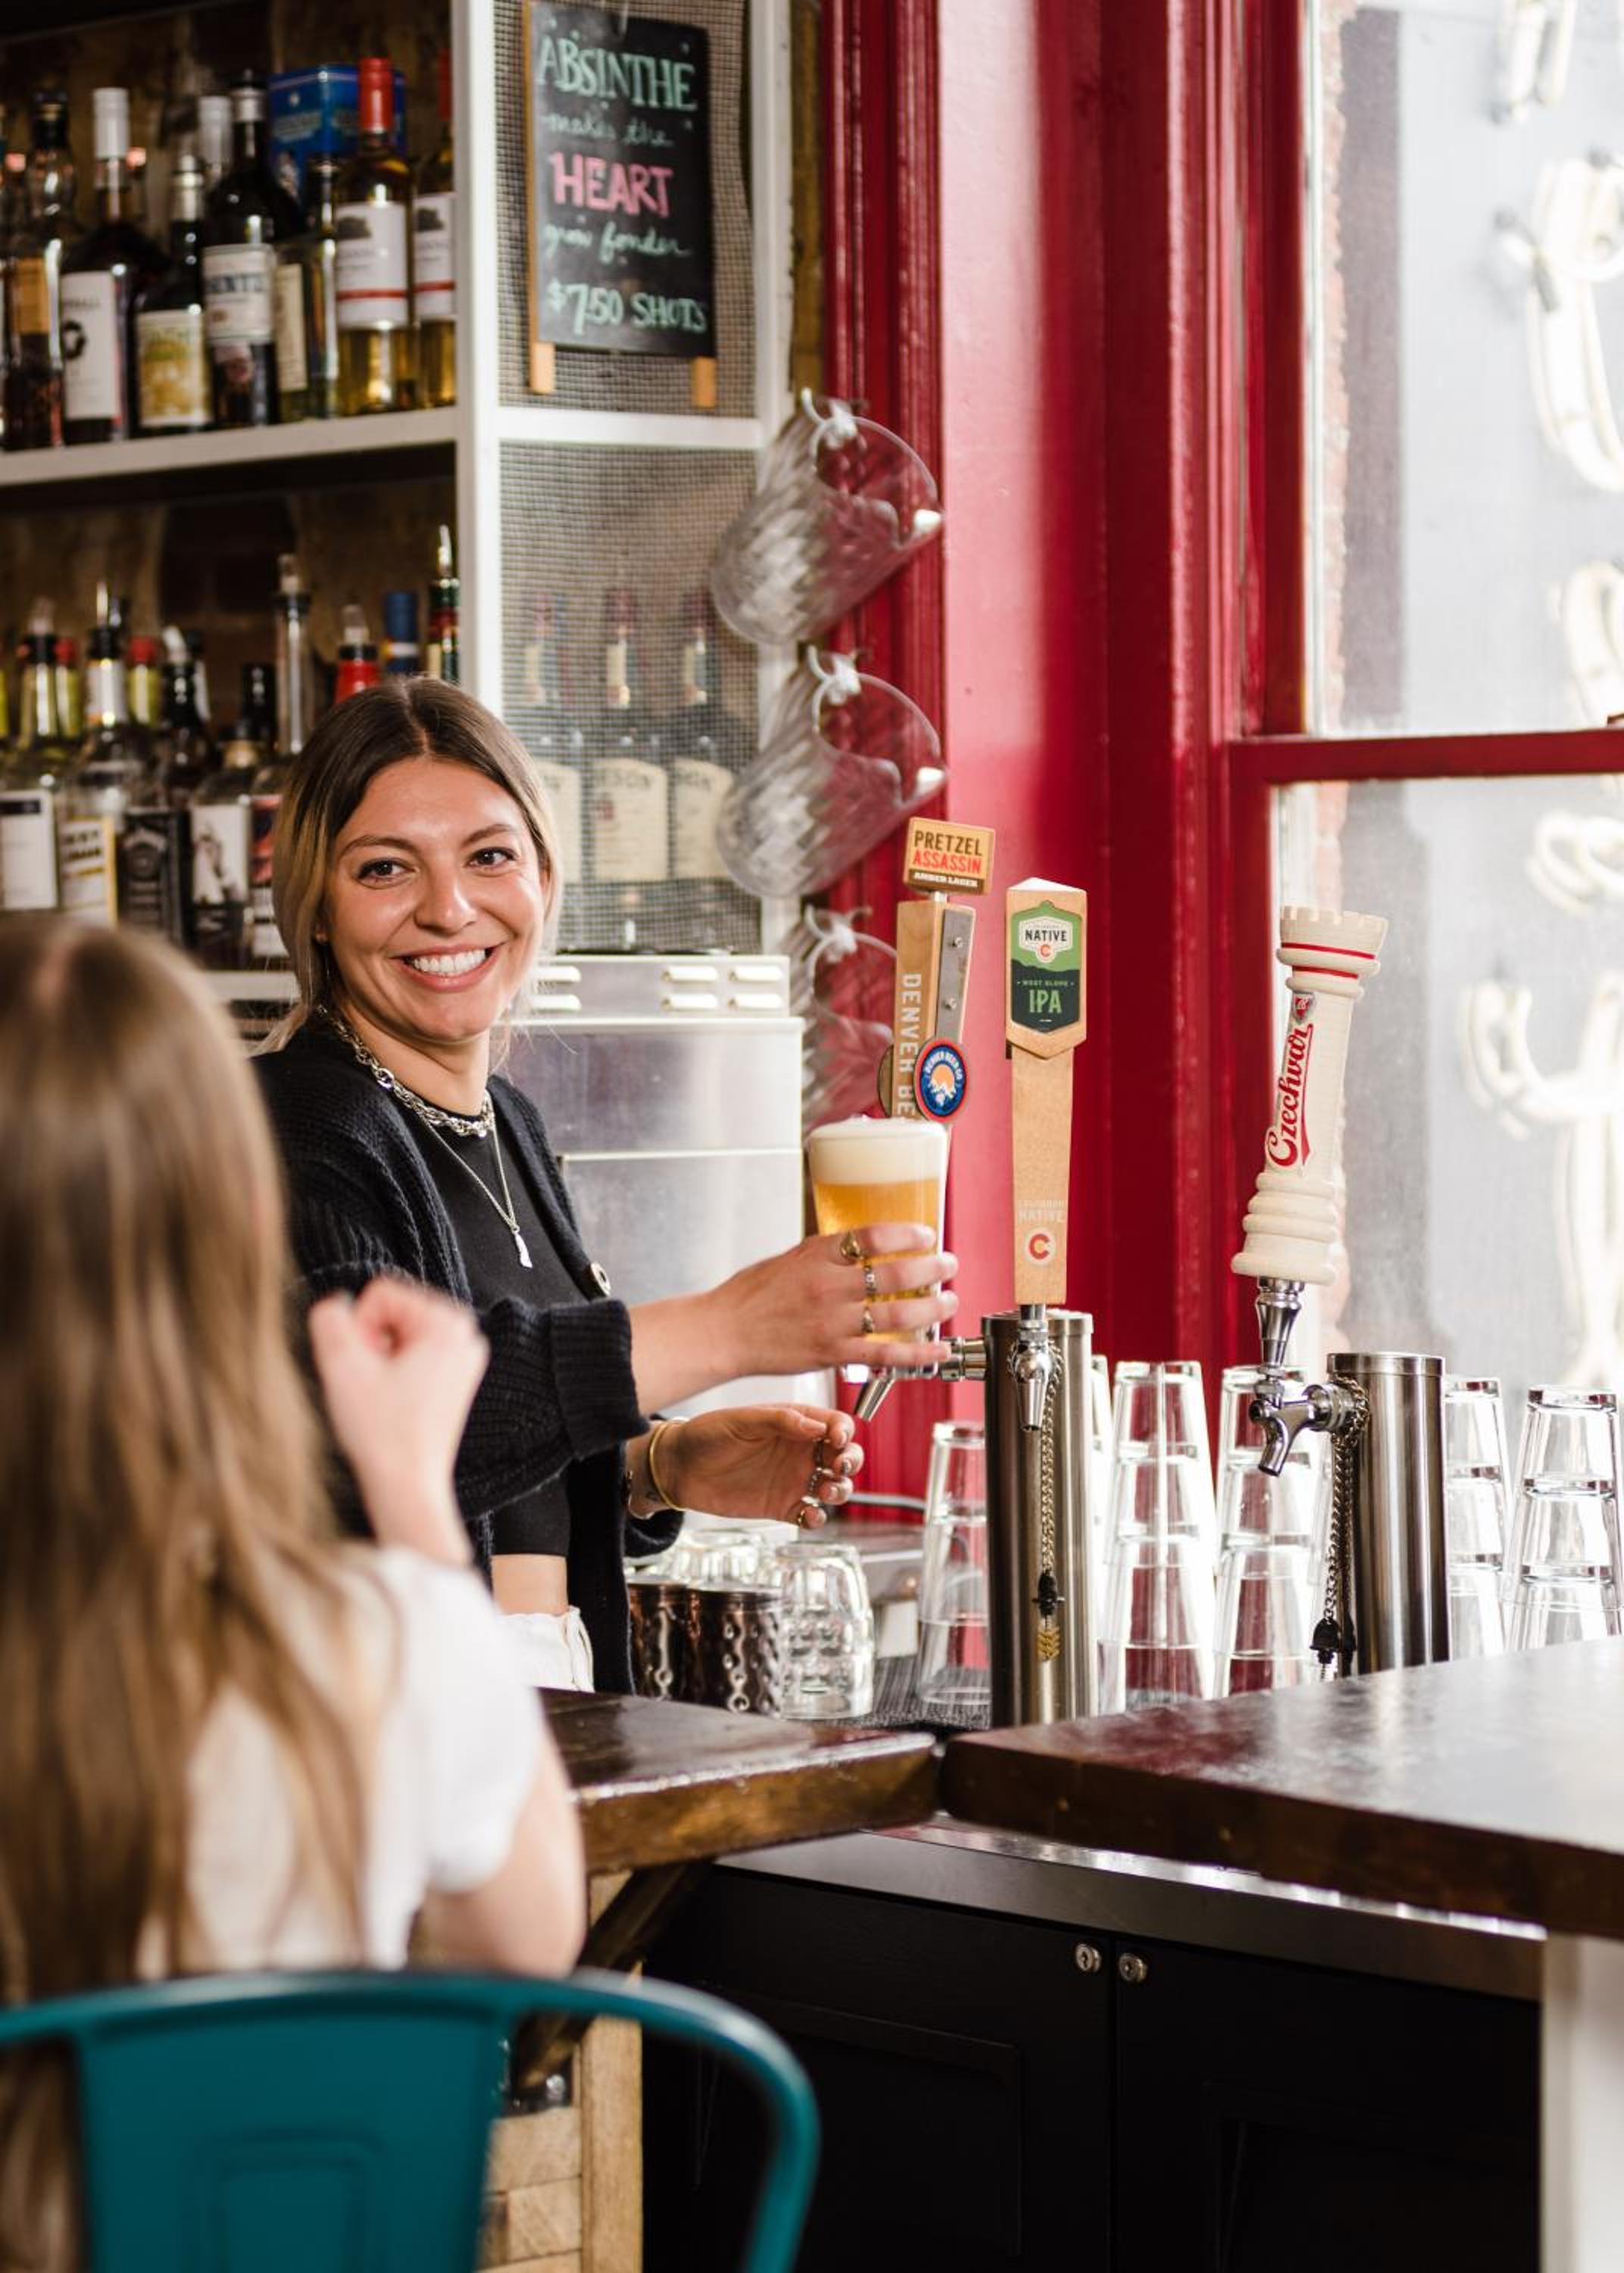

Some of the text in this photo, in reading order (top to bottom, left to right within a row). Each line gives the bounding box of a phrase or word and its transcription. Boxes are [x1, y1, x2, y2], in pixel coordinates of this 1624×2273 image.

[539, 36, 698, 111] ABSINTHE
[548, 151, 675, 218] HEART
[631, 291, 707, 333] SHOTS
[912, 848, 982, 874] ASSASSIN
[914, 830, 982, 856] PRETZEL
[1025, 930, 1067, 942] NATIVE
[1029, 988, 1063, 1014] IPA
[898, 973, 922, 1073] DENVER
[1267, 1022, 1314, 1168] Czechvar
